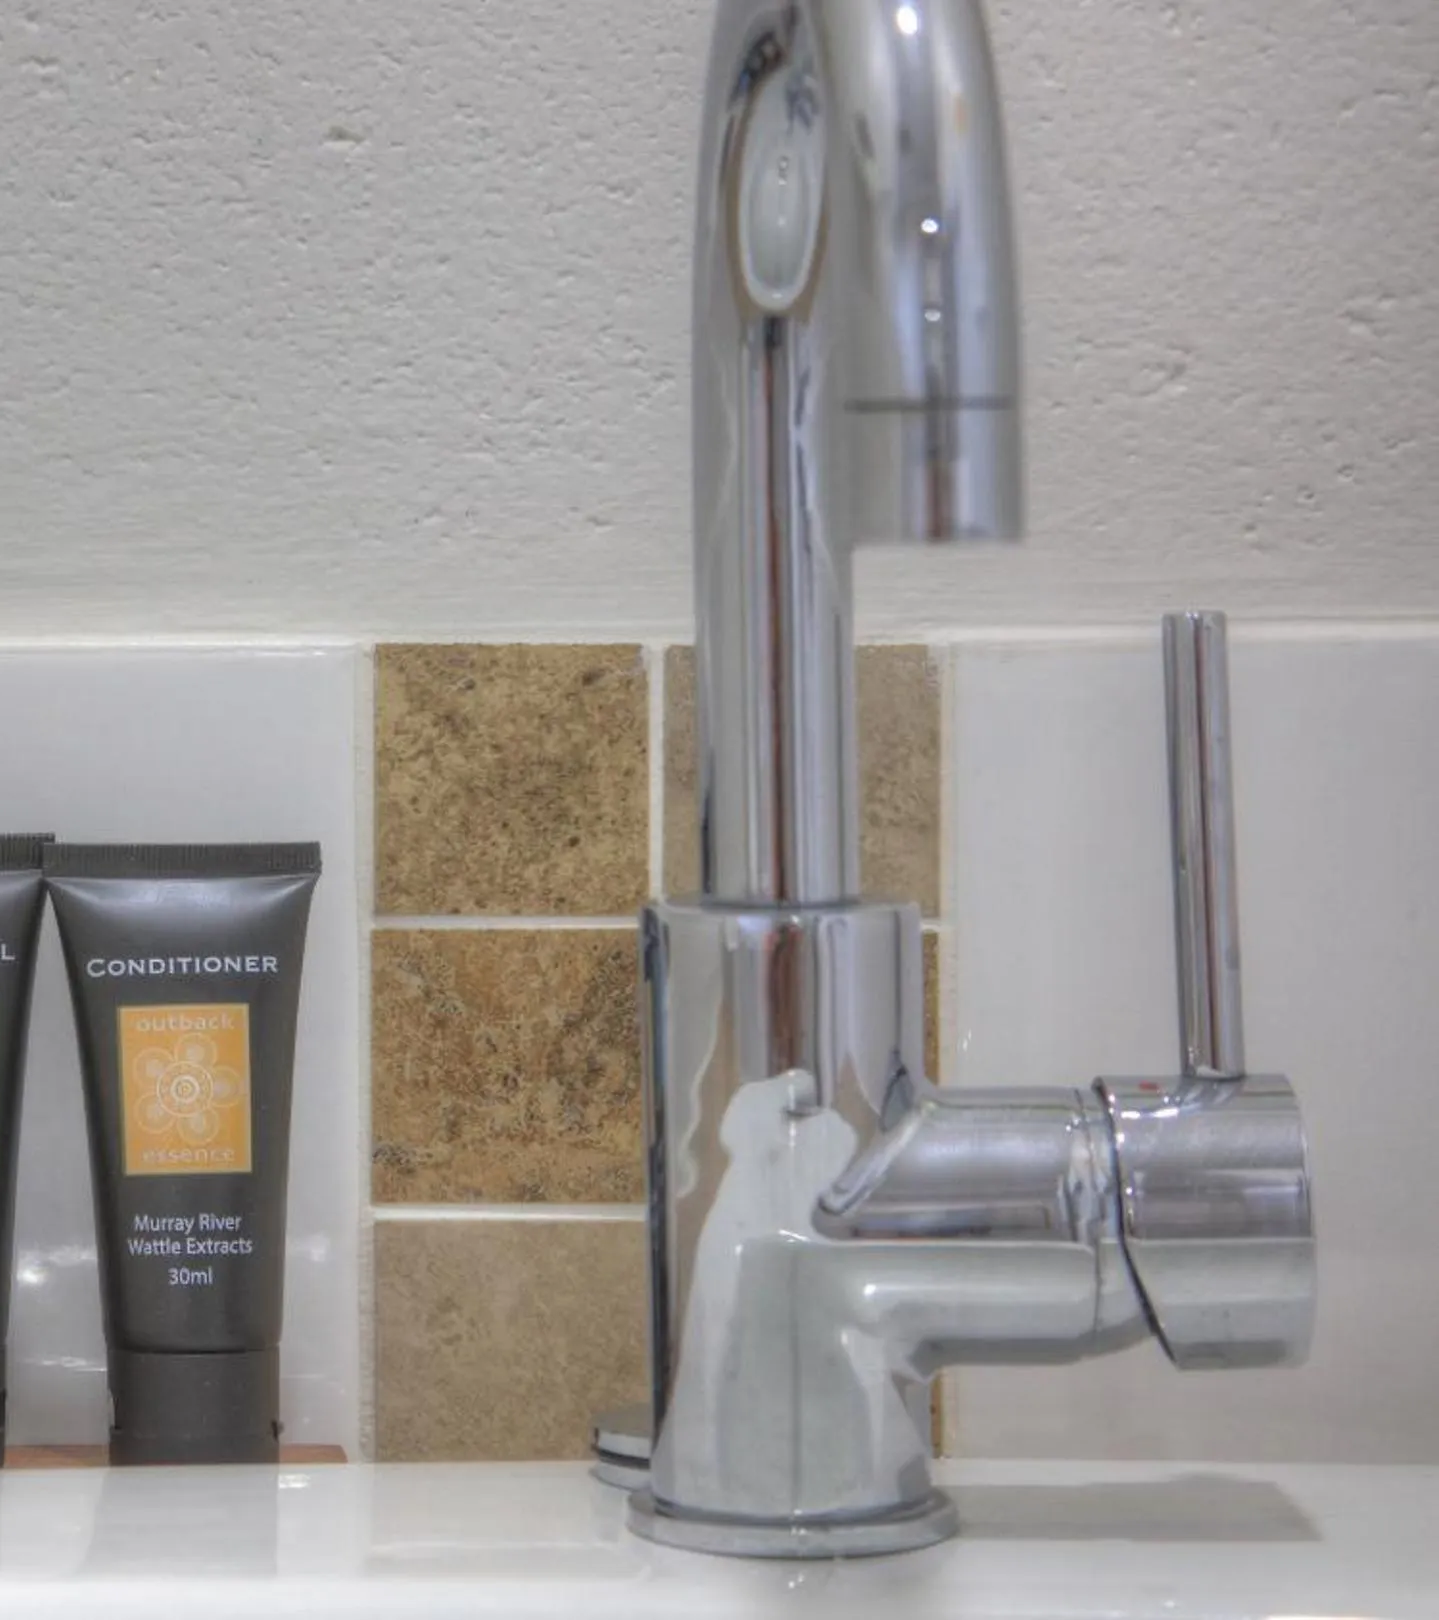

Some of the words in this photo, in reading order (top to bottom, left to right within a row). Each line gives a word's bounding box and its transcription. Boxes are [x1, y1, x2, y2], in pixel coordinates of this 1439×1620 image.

[87, 956, 278, 977] CONDITIONER
[136, 1012, 234, 1031] outback
[142, 1148, 235, 1163] essence
[134, 1215, 194, 1236] Murray
[200, 1214, 242, 1231] River
[128, 1239, 182, 1256] Wattle
[187, 1238, 253, 1255] Extracts
[168, 1268, 212, 1285] 30ml
